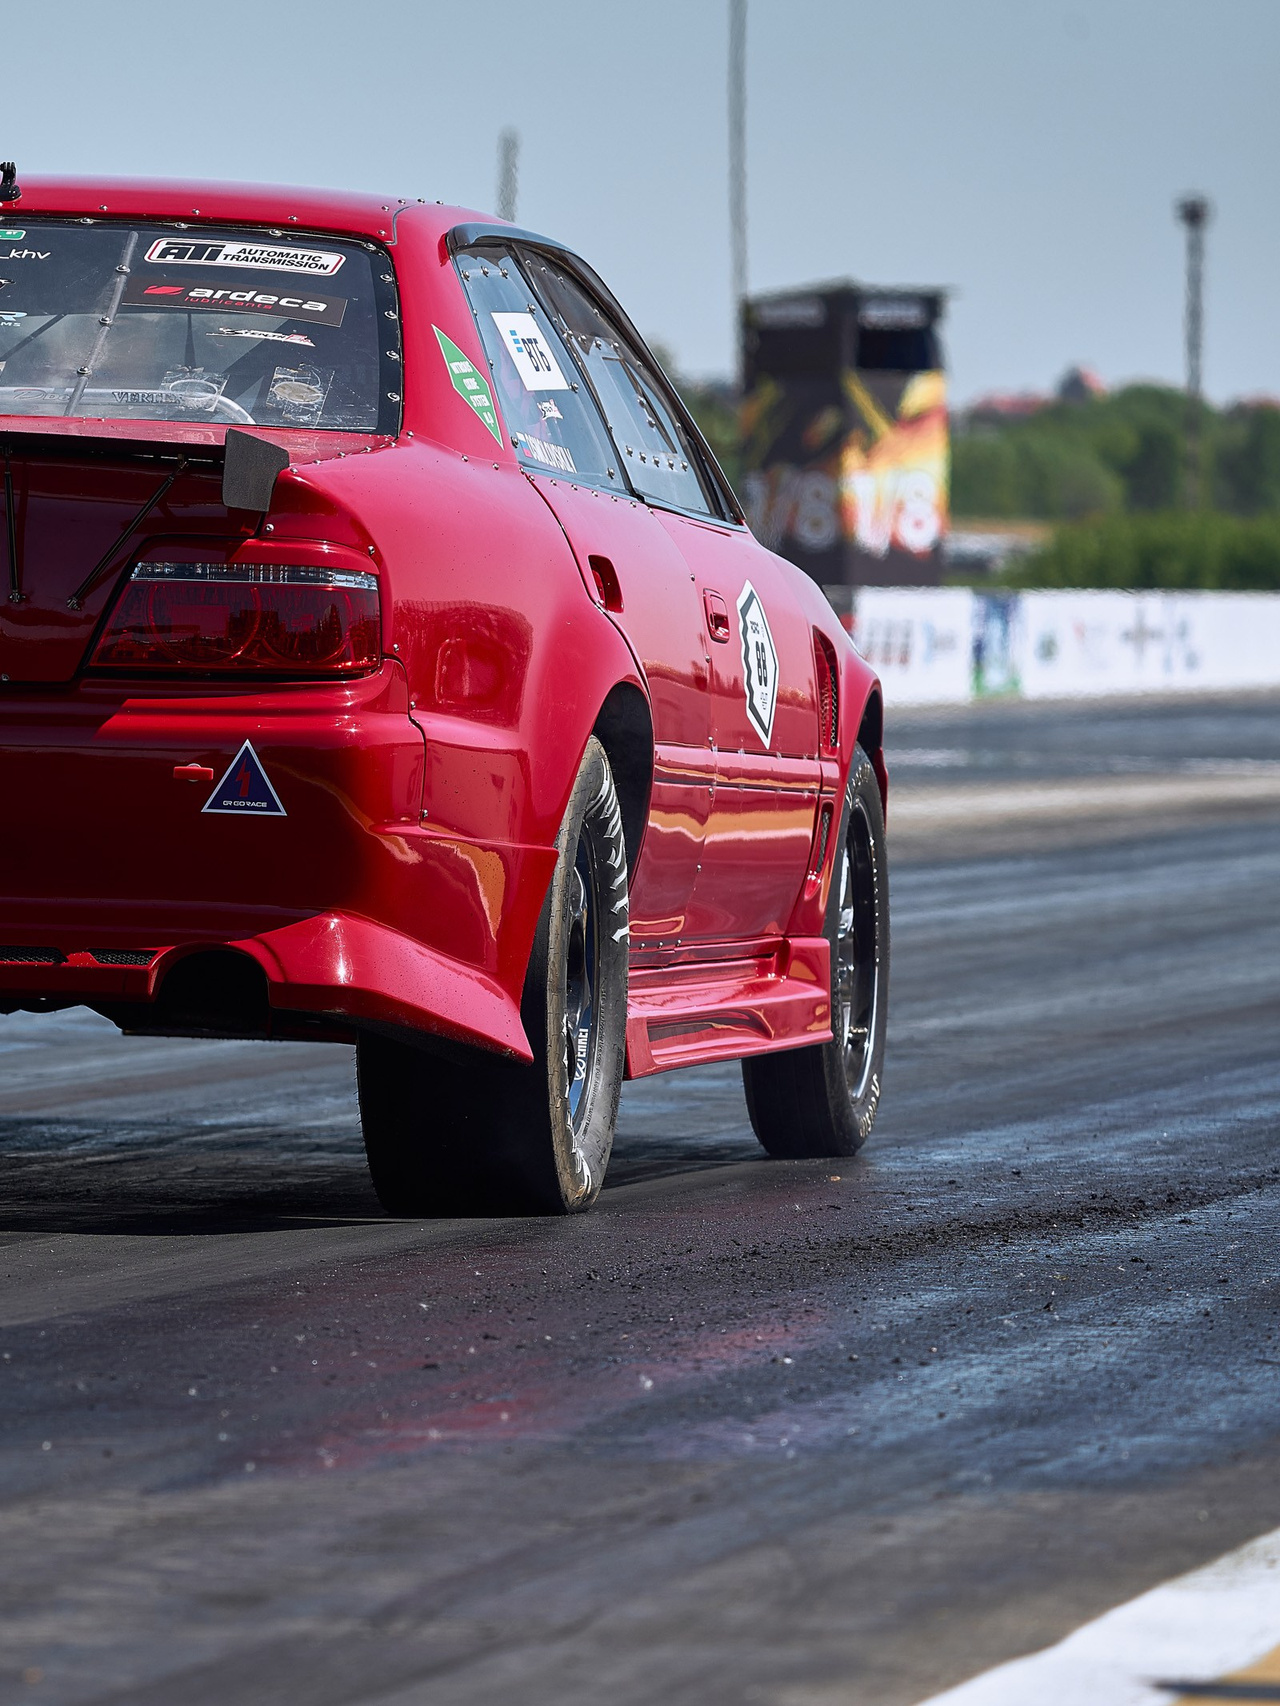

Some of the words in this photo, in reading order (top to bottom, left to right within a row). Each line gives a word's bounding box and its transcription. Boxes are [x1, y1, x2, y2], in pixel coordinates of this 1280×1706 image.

[222, 253, 330, 272] TRANSMISSION
[236, 247, 324, 263] AUTOMATIC
[183, 296, 273, 310] lubricants
[187, 286, 328, 312] ardeca
[755, 641, 768, 687] 88
